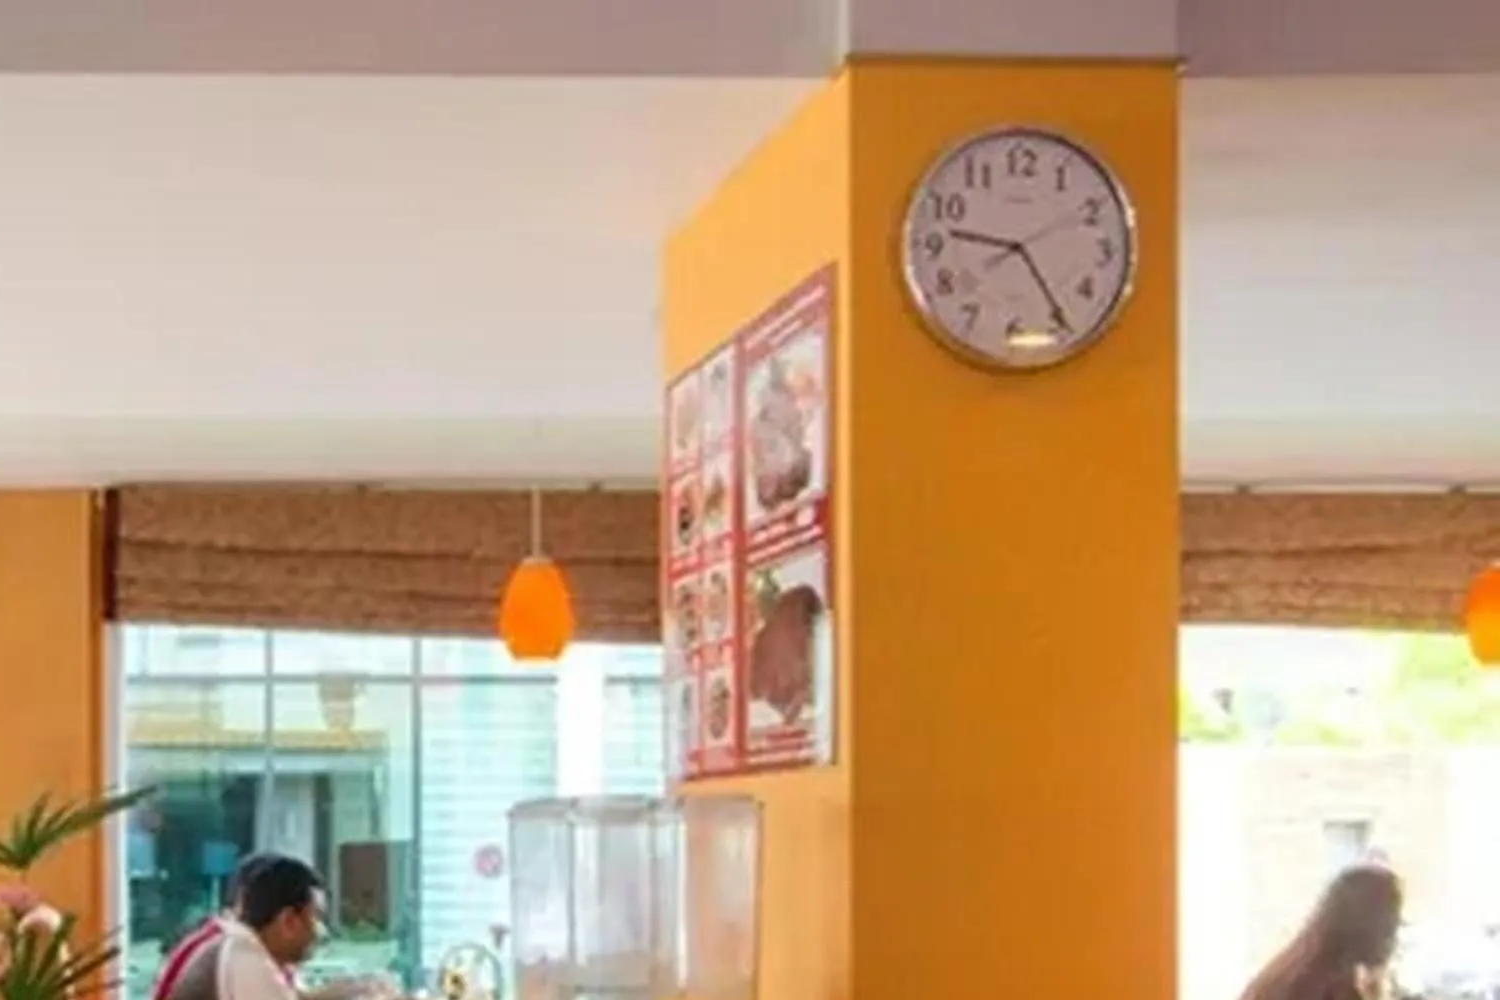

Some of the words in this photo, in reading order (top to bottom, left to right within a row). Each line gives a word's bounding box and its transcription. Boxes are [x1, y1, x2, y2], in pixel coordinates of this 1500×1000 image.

[964, 153, 991, 189] 11
[1006, 148, 1038, 177] 12
[1054, 164, 1066, 192] 1
[931, 192, 966, 222] 10
[1080, 197, 1100, 226] 2
[924, 232, 944, 261] 9
[1097, 237, 1114, 267] 3
[935, 267, 954, 296] 8
[1076, 276, 1094, 300] 4
[961, 302, 980, 330] 7
